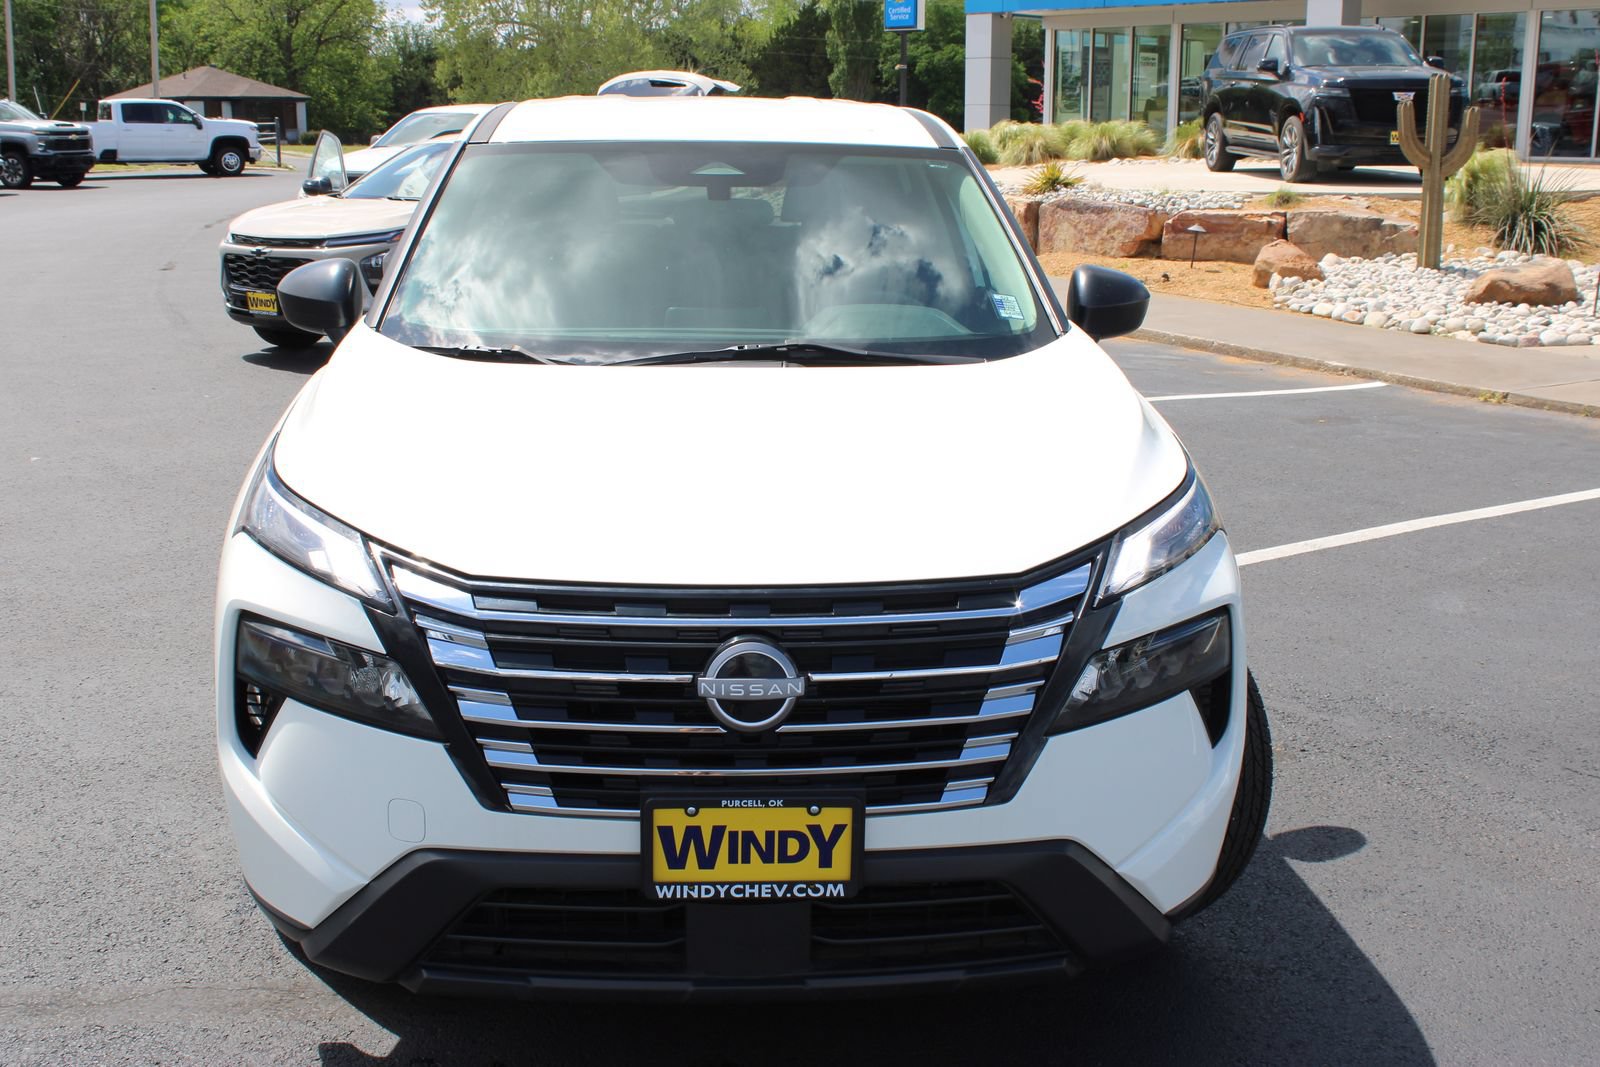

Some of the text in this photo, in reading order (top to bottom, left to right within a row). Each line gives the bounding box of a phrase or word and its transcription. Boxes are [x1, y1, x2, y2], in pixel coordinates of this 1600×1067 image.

[888, 6, 911, 14] Certified
[249, 296, 277, 309] WINDY
[701, 682, 802, 696] NISSAN
[721, 799, 784, 808] PURCELL, OK
[656, 824, 848, 870] WINDY
[655, 883, 845, 899] WINDYCHEV.COM
